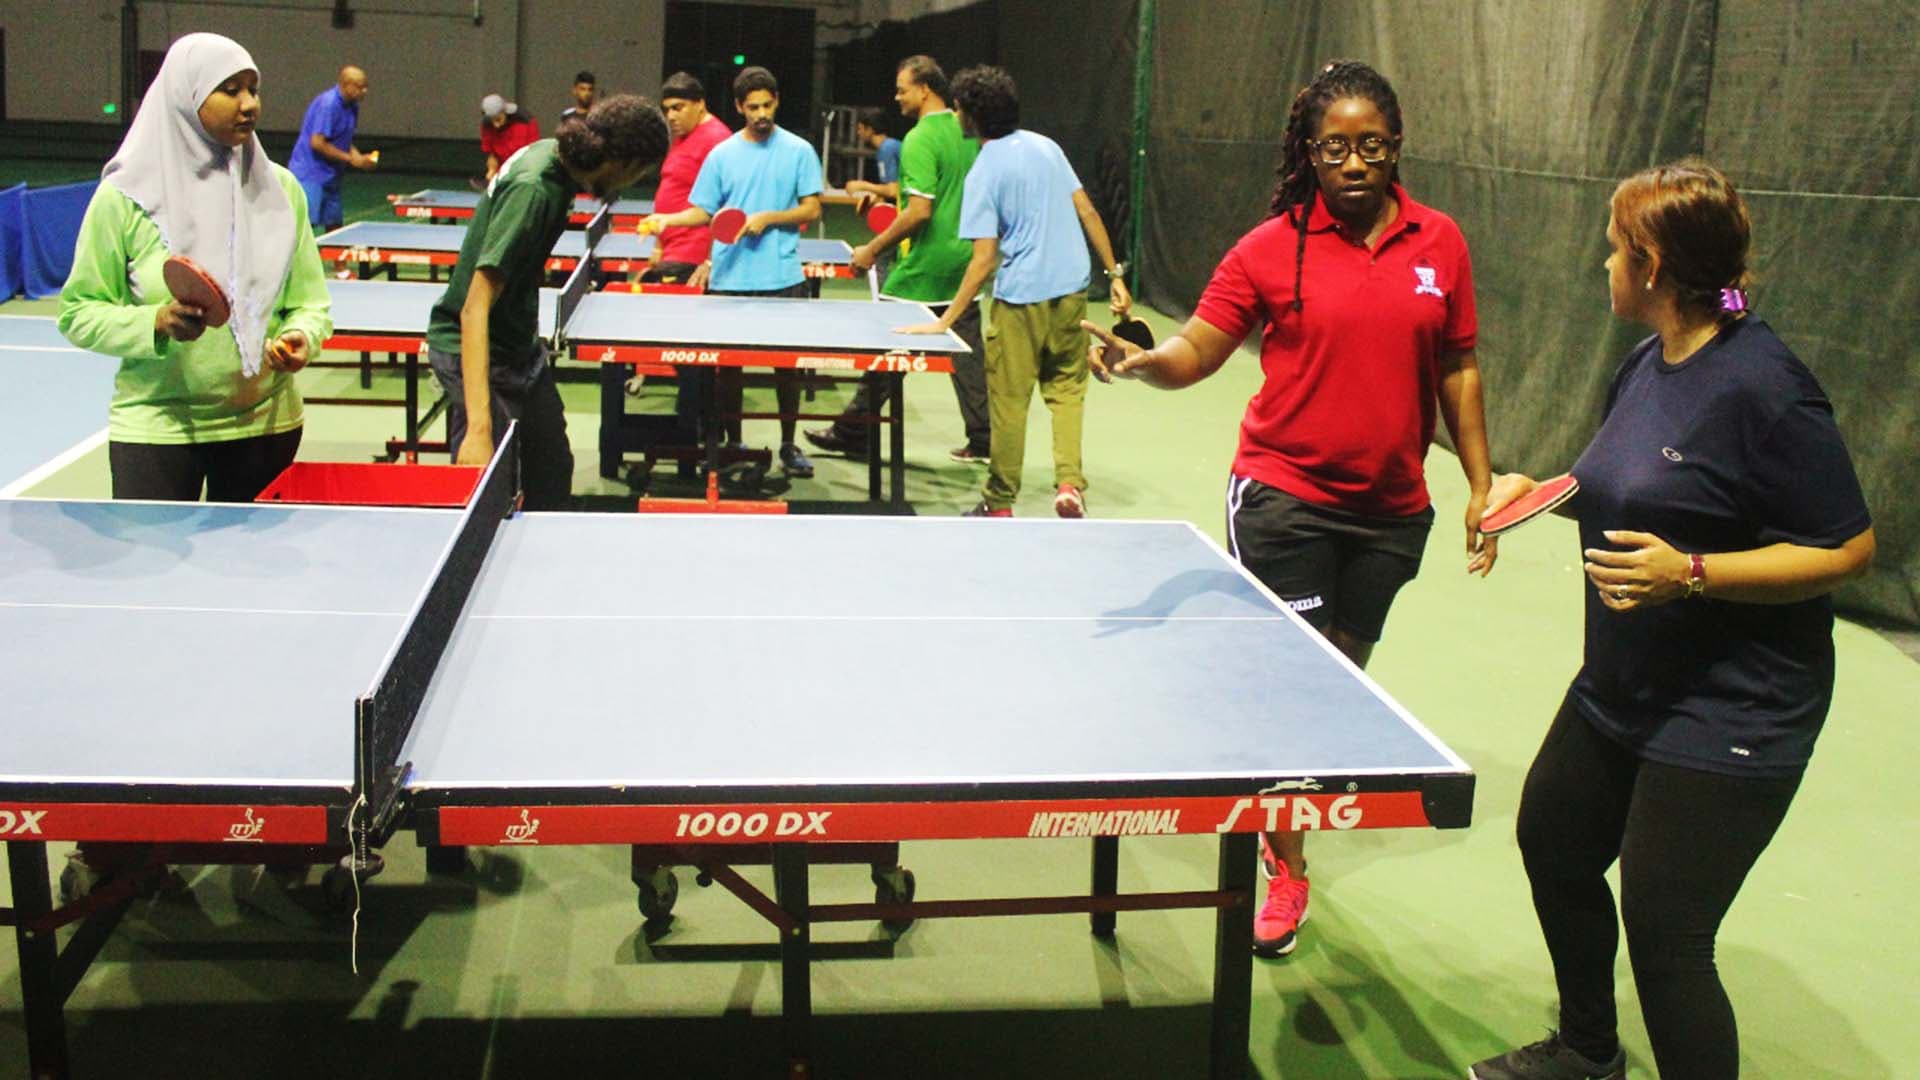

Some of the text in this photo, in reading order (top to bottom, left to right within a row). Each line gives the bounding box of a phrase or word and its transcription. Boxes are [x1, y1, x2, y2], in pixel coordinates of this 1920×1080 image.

[339, 248, 380, 262] STAG
[803, 264, 836, 278] TAG
[660, 351, 720, 363] 1000 DX
[868, 354, 928, 371] STAG
[1287, 596, 1323, 611] oma
[1028, 796, 1363, 837] INTERNATIONAL STAG
[676, 812, 832, 837] 1000 DX
